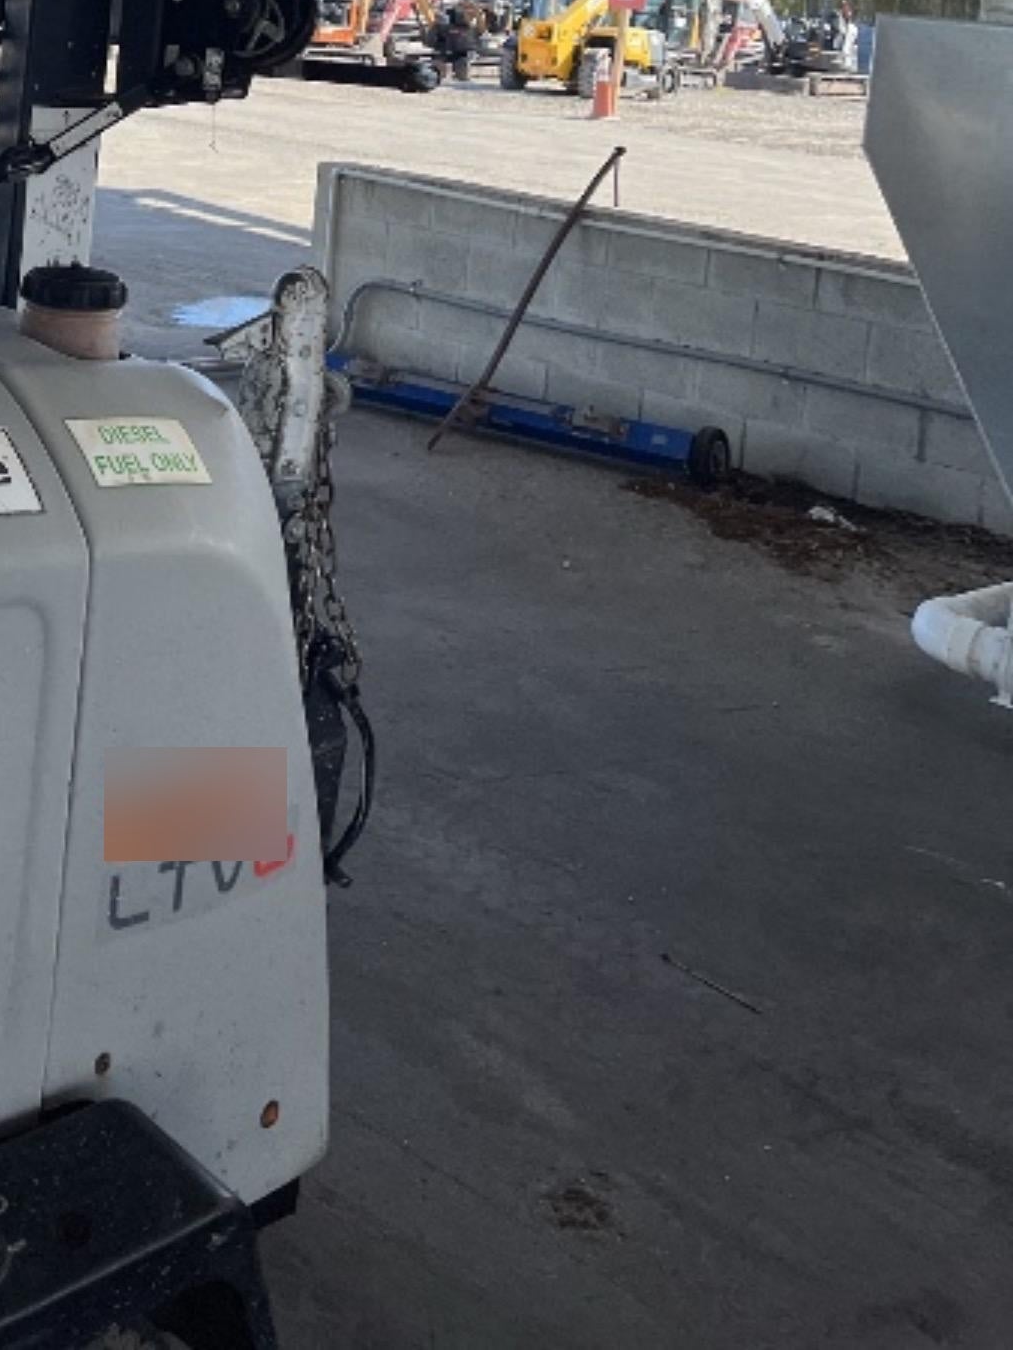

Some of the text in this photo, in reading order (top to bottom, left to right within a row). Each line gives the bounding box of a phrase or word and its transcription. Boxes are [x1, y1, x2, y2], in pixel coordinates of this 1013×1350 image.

[98, 424, 172, 445] DIESEL
[94, 451, 199, 476] FUEL ONLY
